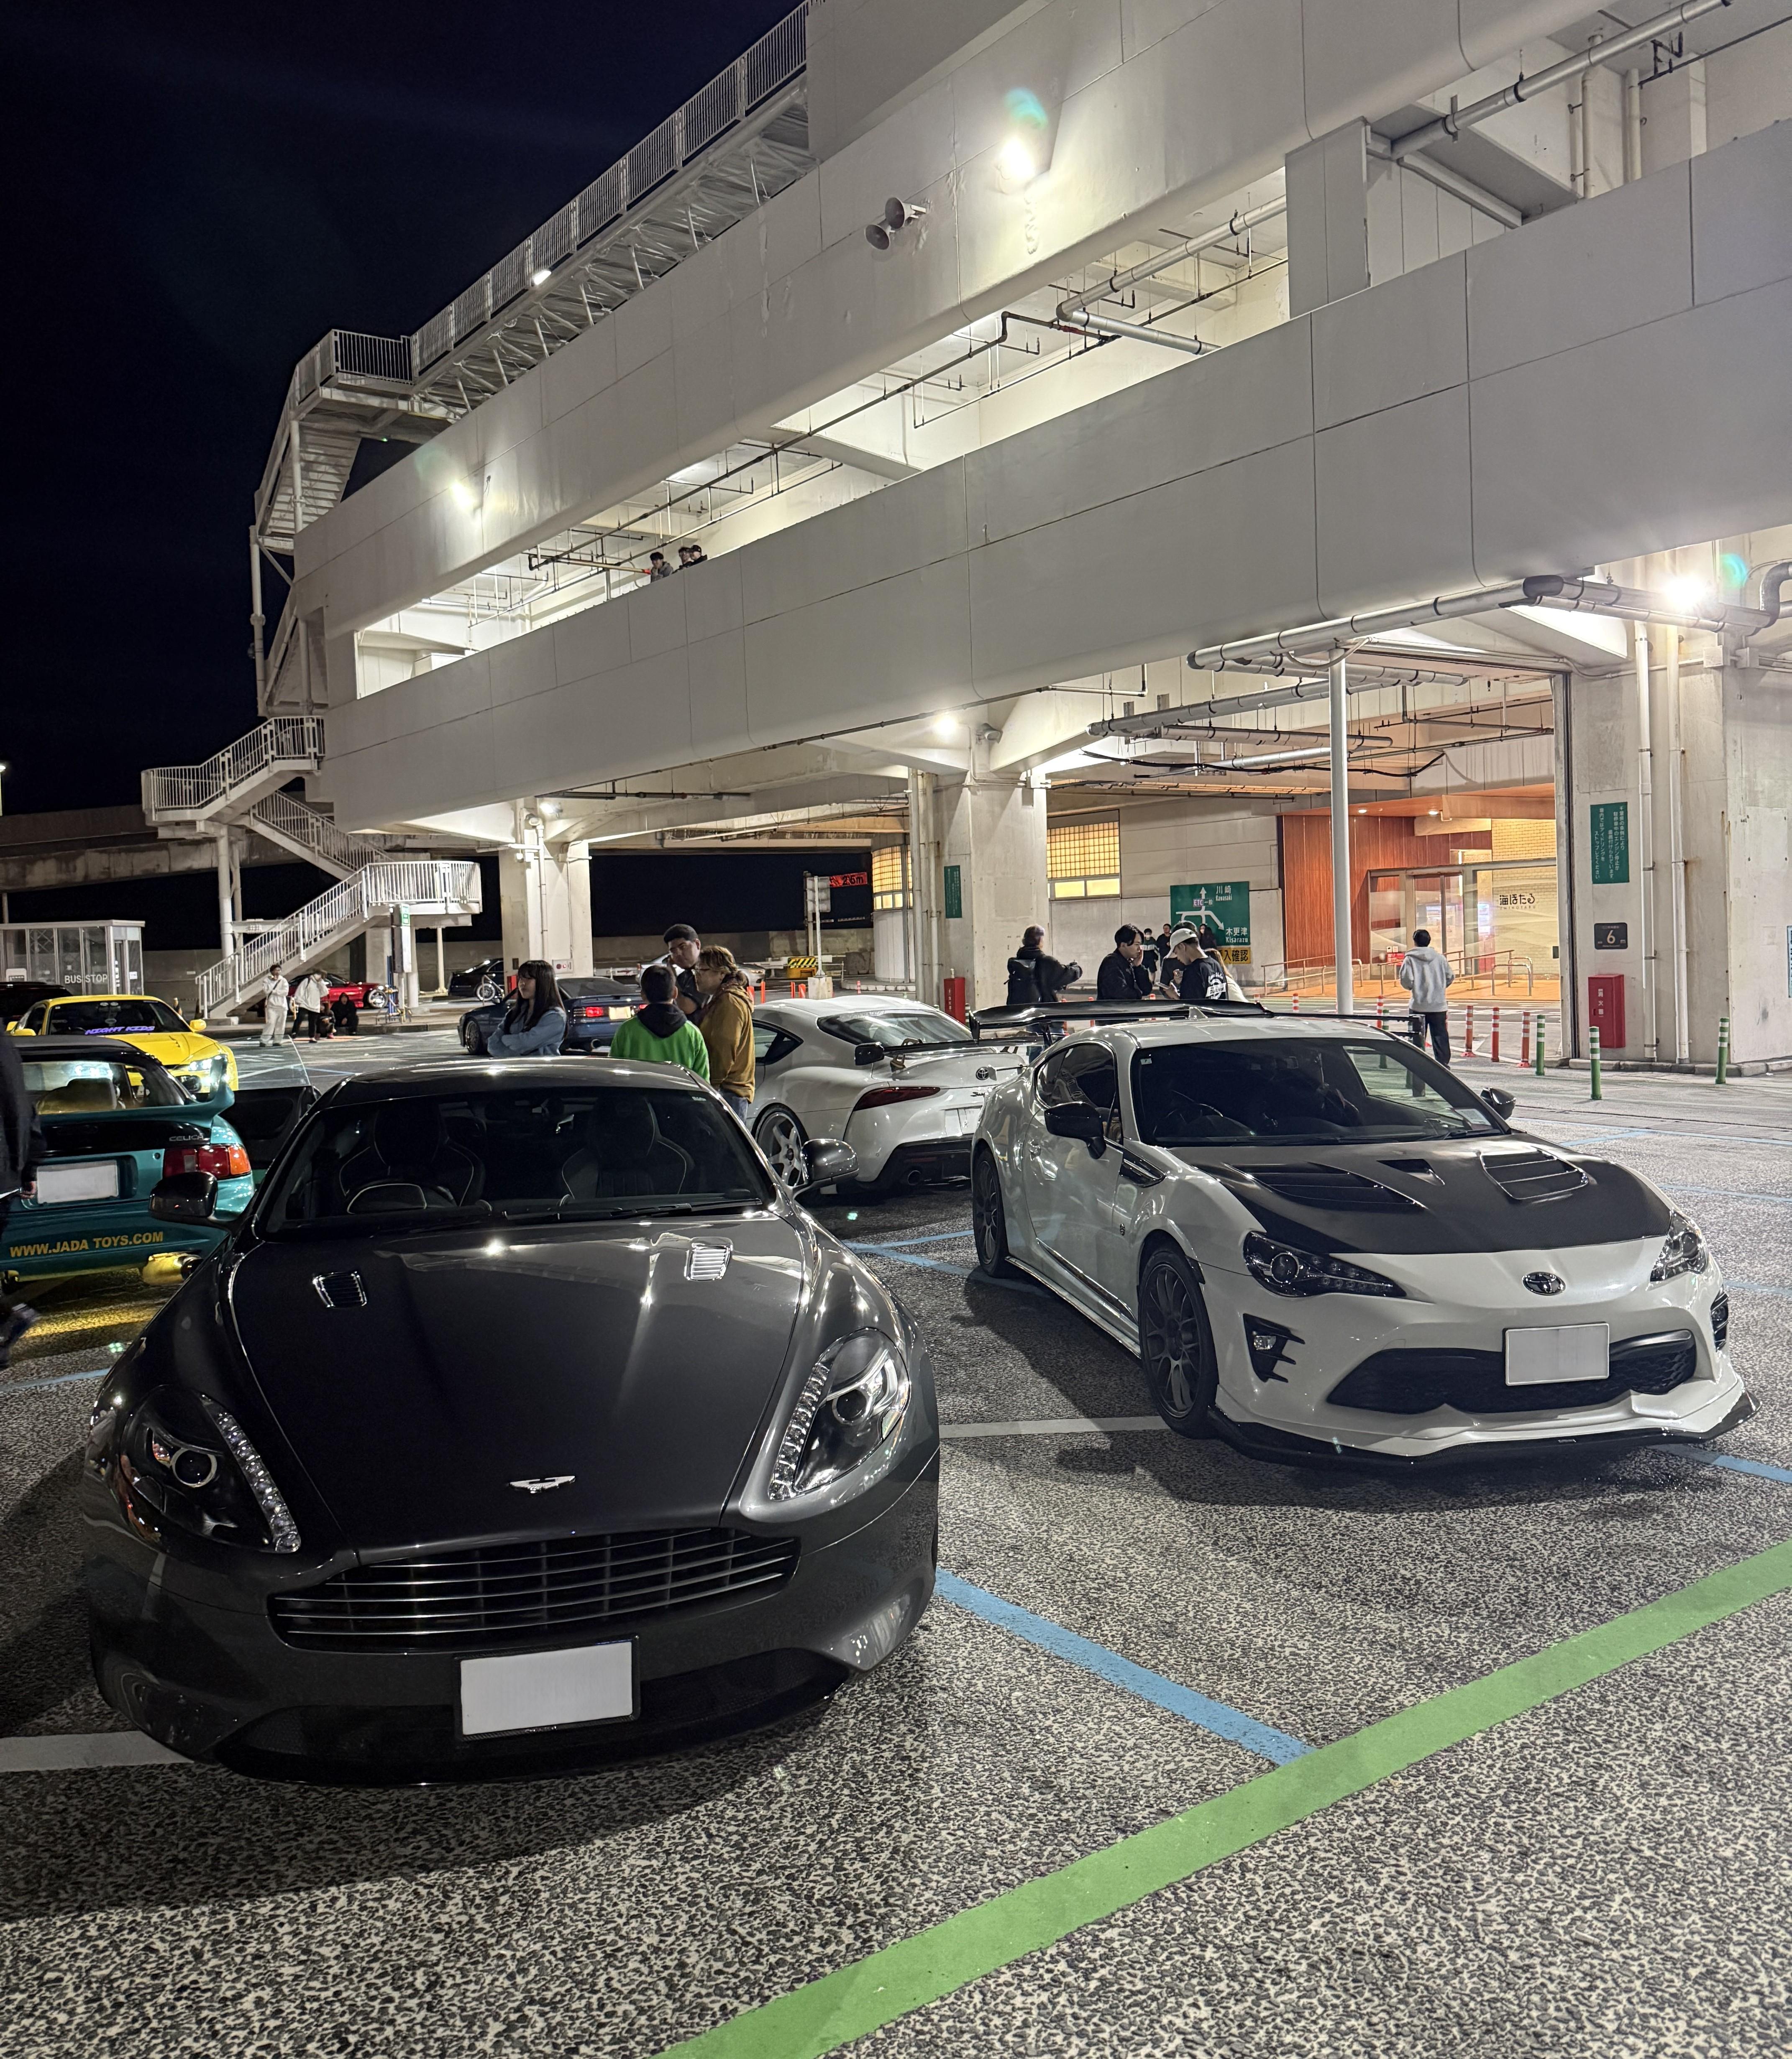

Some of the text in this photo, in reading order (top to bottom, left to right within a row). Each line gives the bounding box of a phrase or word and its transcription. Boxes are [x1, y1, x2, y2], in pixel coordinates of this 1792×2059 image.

[1216, 885, 1231, 894] 川崎
[1500, 893, 1535, 905] 海ほたる
[1226, 927, 1247, 936] 木更津
[1607, 930, 1615, 944] 6
[1219, 950, 1248, 962] 入確認
[64, 974, 108, 984] BUS STOP
[85, 1026, 125, 1035] NIGHT
[10, 1231, 164, 1258] WWW.JADA TOYS.COM
